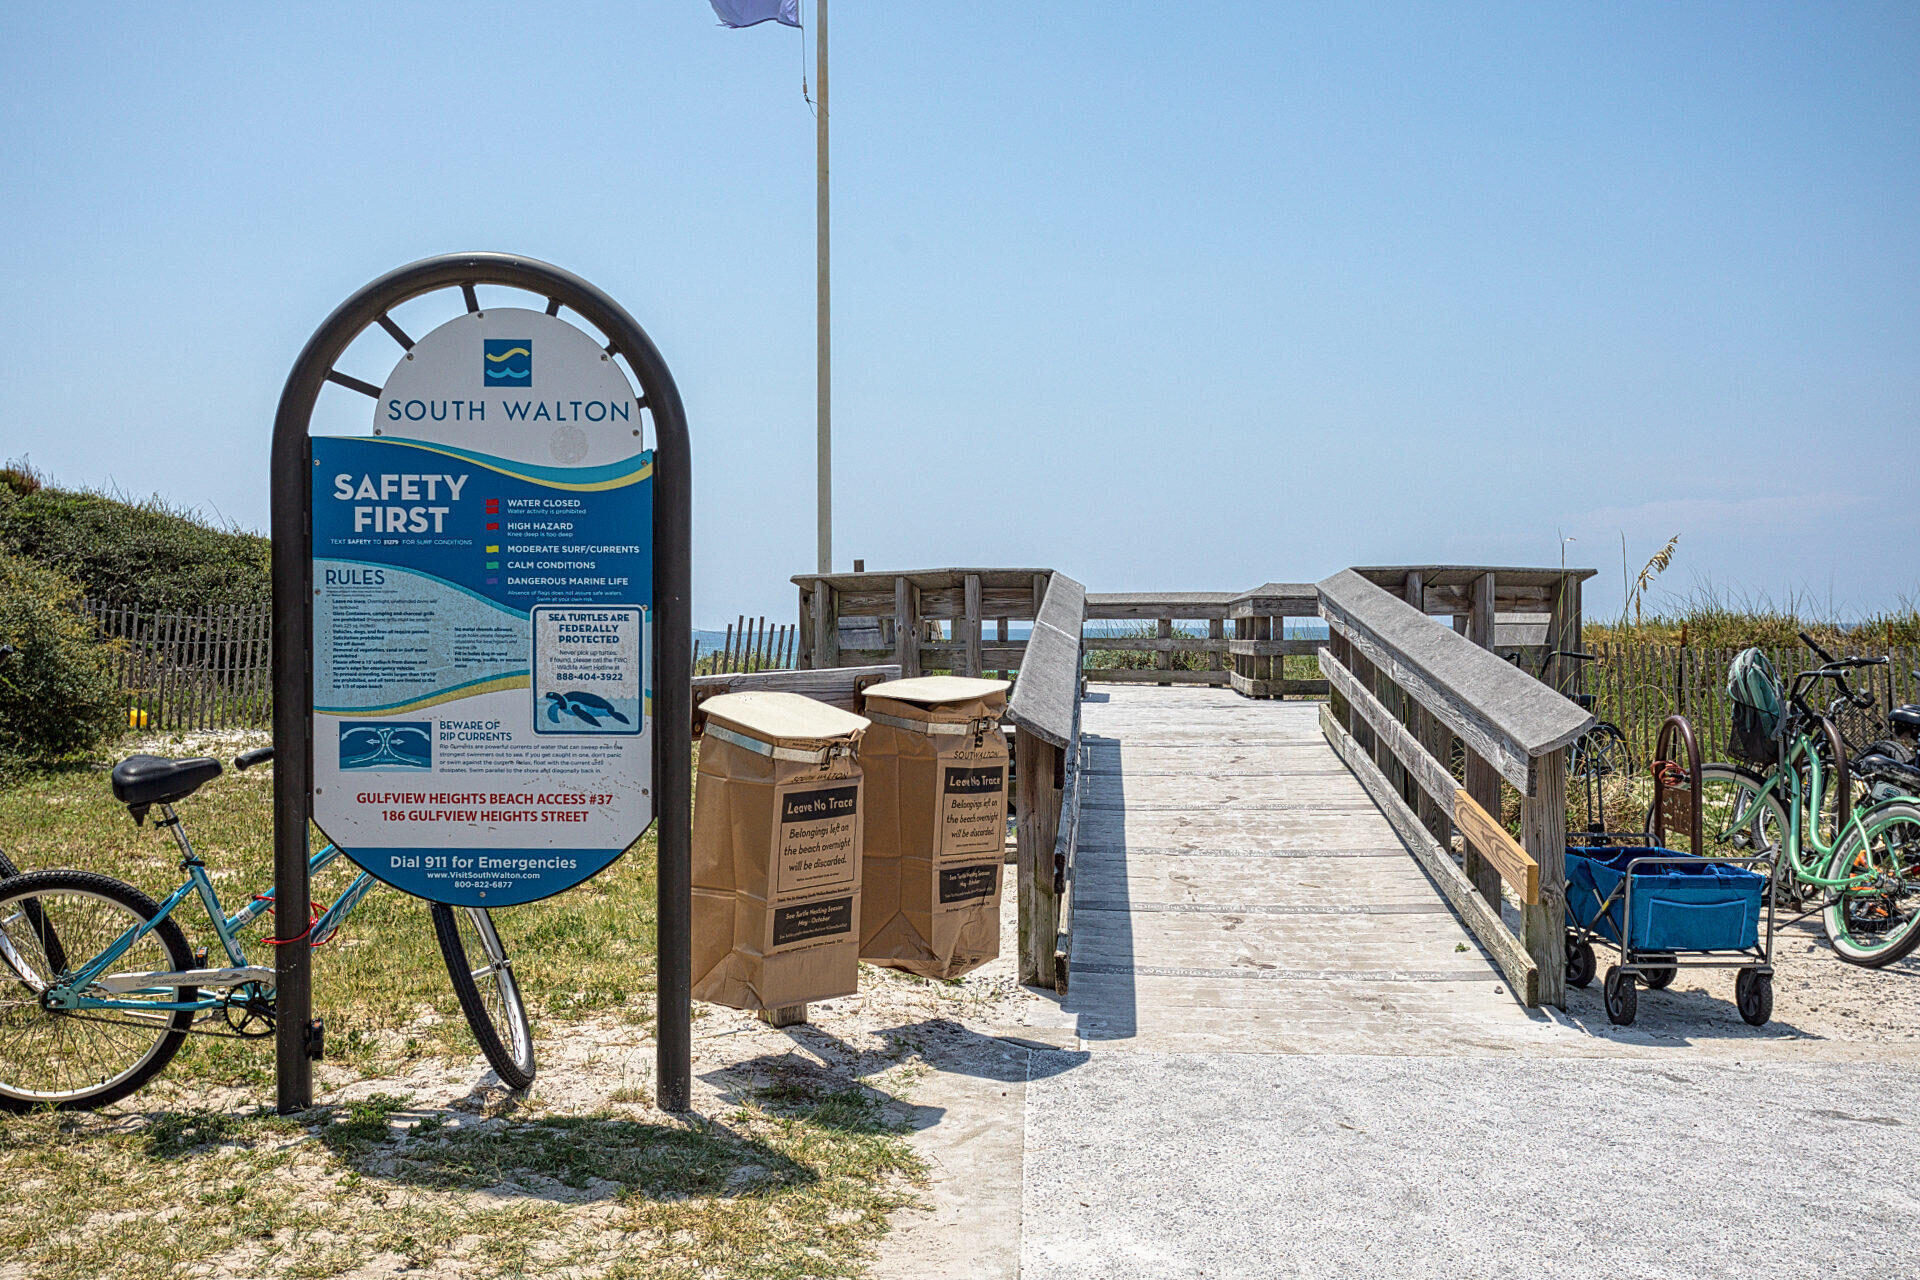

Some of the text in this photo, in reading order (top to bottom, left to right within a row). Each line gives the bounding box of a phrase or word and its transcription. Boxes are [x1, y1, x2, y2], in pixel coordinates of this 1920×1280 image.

[388, 400, 630, 421] SOUTH WALTON
[333, 474, 468, 500] SAFETY
[355, 506, 449, 533] FIRST
[562, 545, 640, 554] SURF/CURRENTS
[326, 570, 385, 585] RULES
[556, 673, 623, 681] 888-404-3922
[440, 721, 500, 730] BEWARE OF
[440, 732, 512, 740] RIP CURRENTS
[357, 793, 613, 804] GULFVIEW HEIGHTS BEACH ACCESS #37
[787, 798, 853, 814] Leave No Trace
[382, 810, 589, 822] 186 GULFVIEW HEIGHTS STREET
[789, 826, 828, 839] Belongings
[830, 823, 840, 836] left
[784, 837, 850, 856] the beach overnight
[391, 856, 576, 870] Dial 911 for Emergencies
[789, 854, 847, 871] will be discarded.
